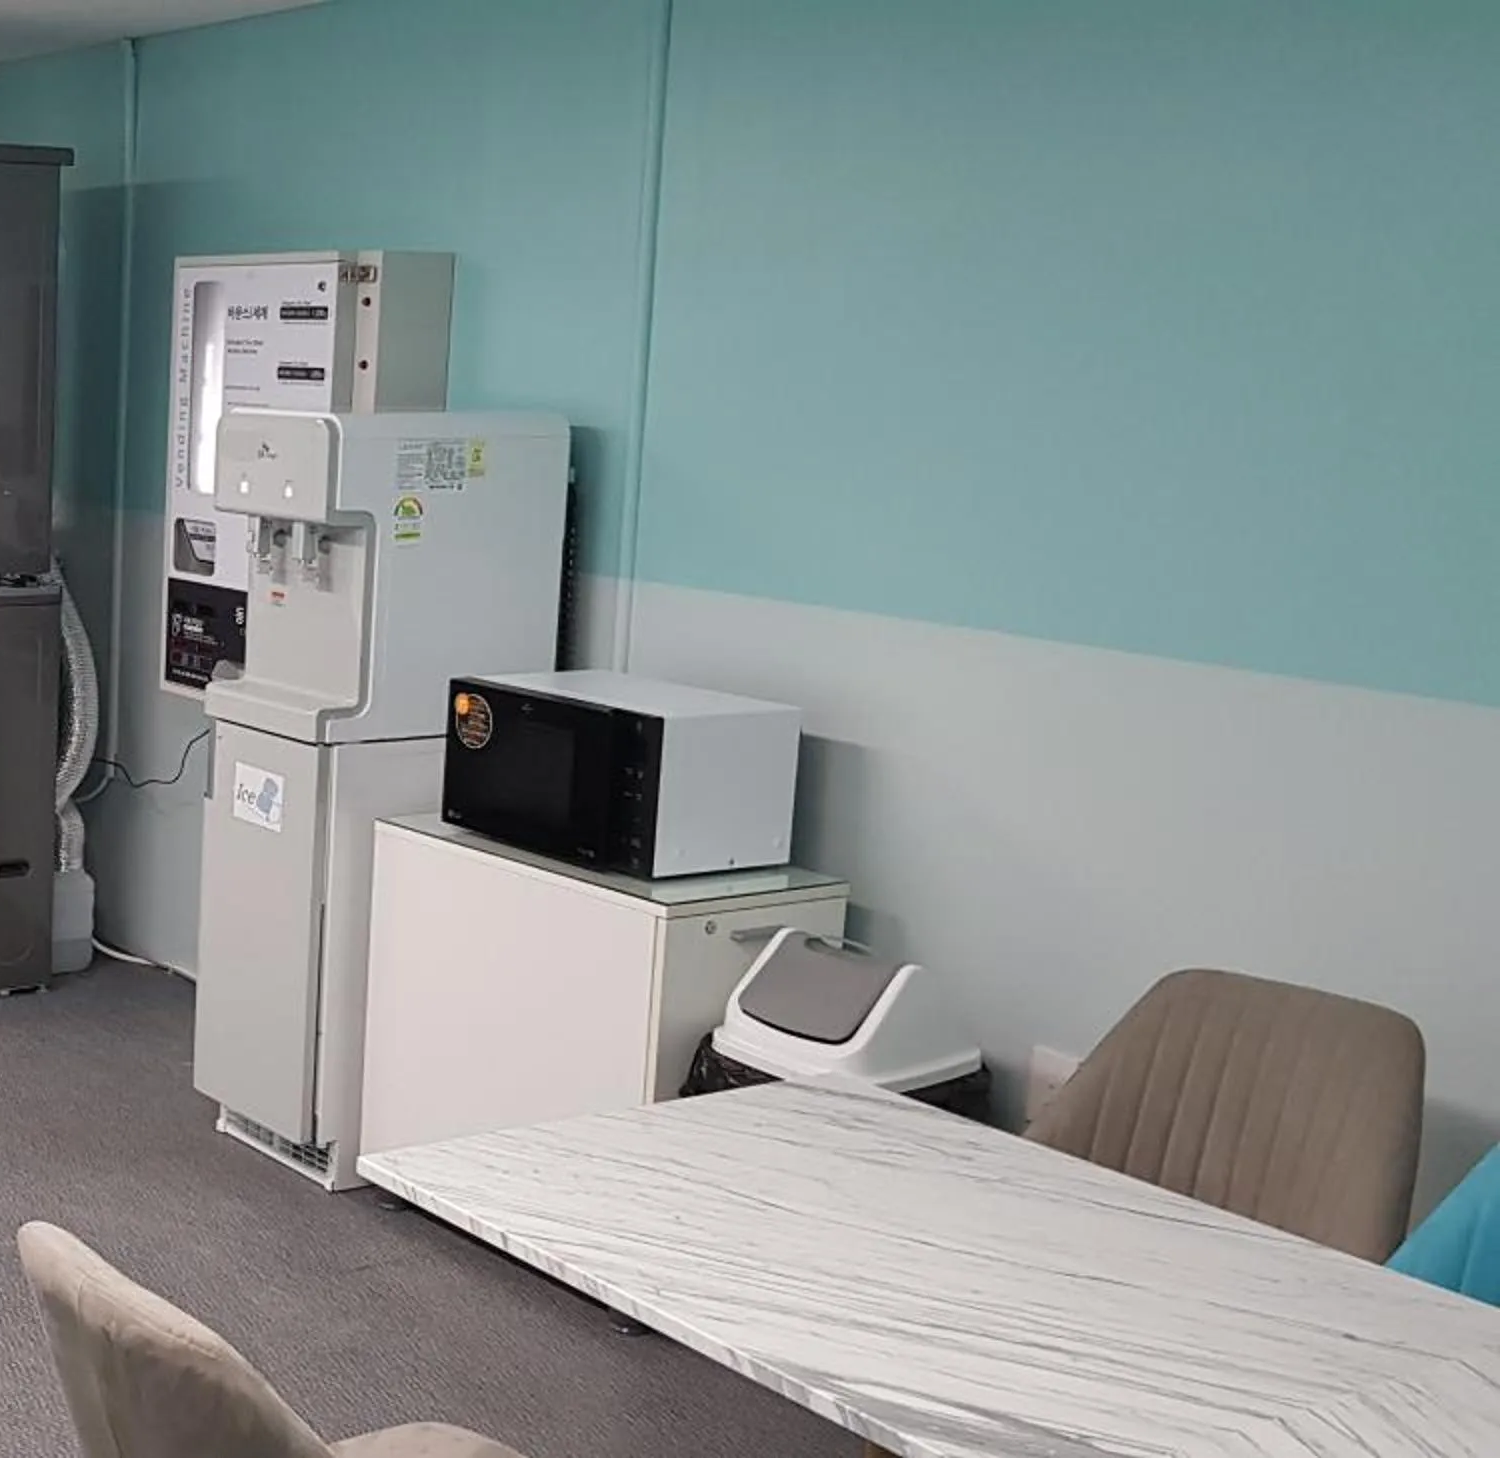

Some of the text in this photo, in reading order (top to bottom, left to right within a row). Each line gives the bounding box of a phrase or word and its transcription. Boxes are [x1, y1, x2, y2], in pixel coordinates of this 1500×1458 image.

[175, 287, 192, 488] Vending Machine
[236, 783, 257, 805] Ice
